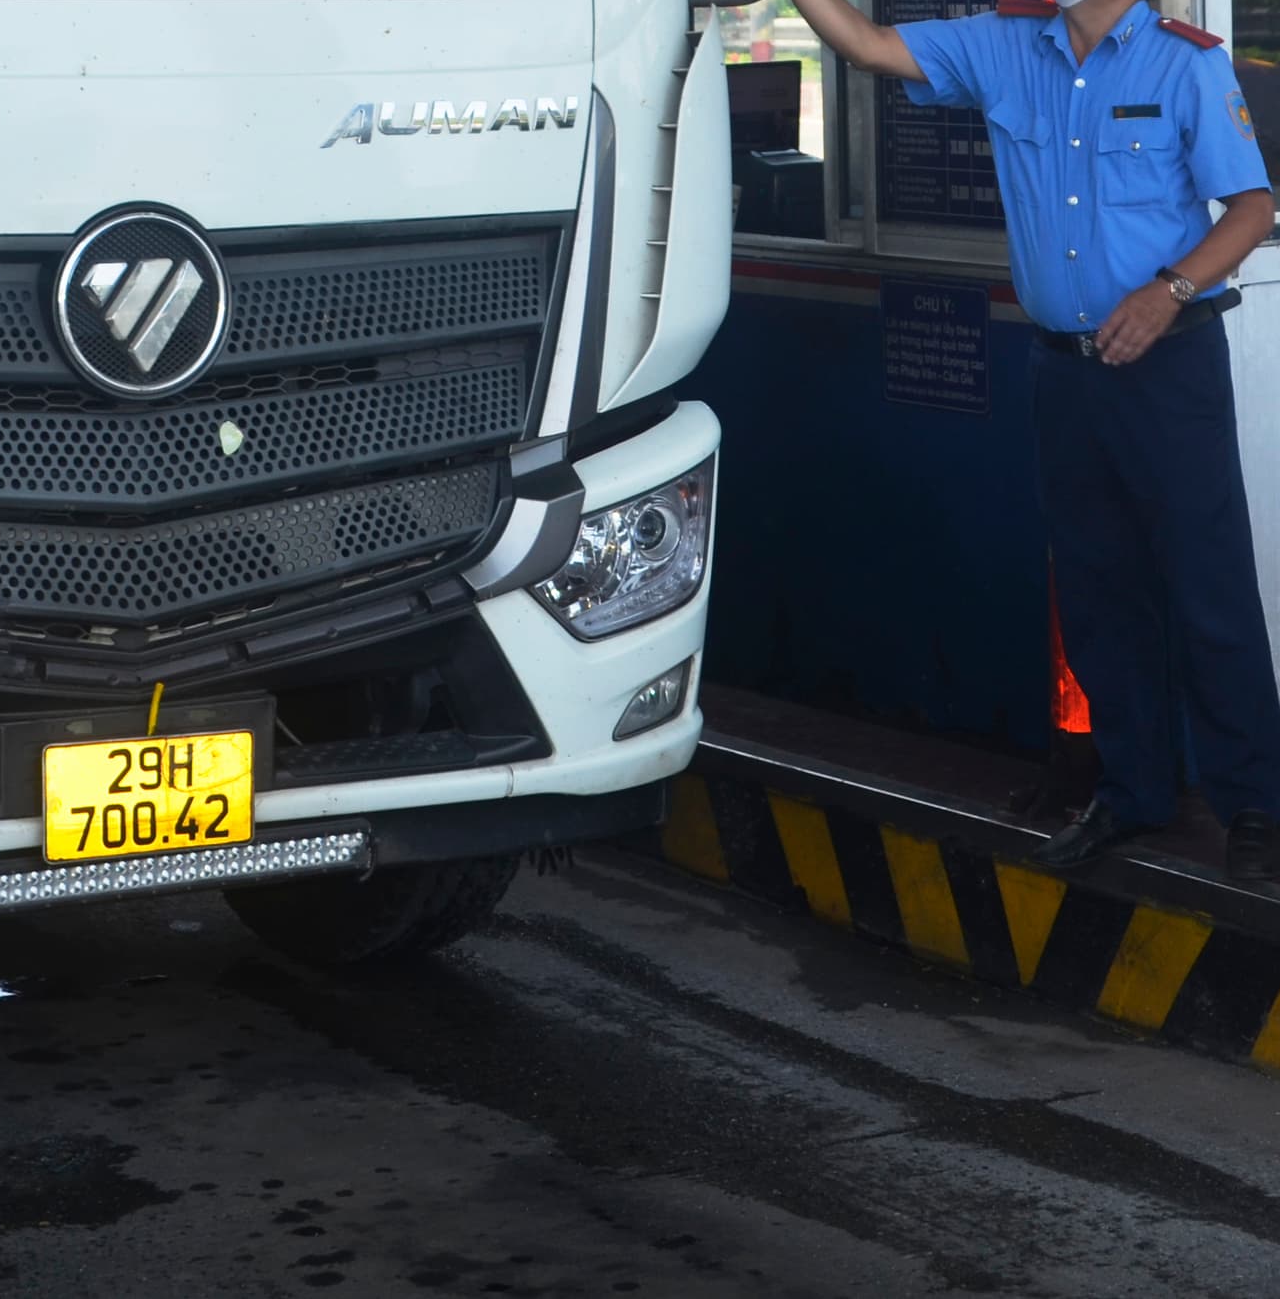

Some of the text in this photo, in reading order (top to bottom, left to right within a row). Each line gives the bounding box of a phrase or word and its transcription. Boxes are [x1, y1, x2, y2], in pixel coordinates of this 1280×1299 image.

[320, 96, 579, 149] AUMAN
[108, 743, 194, 794] 29H
[71, 794, 230, 852] 700.42
